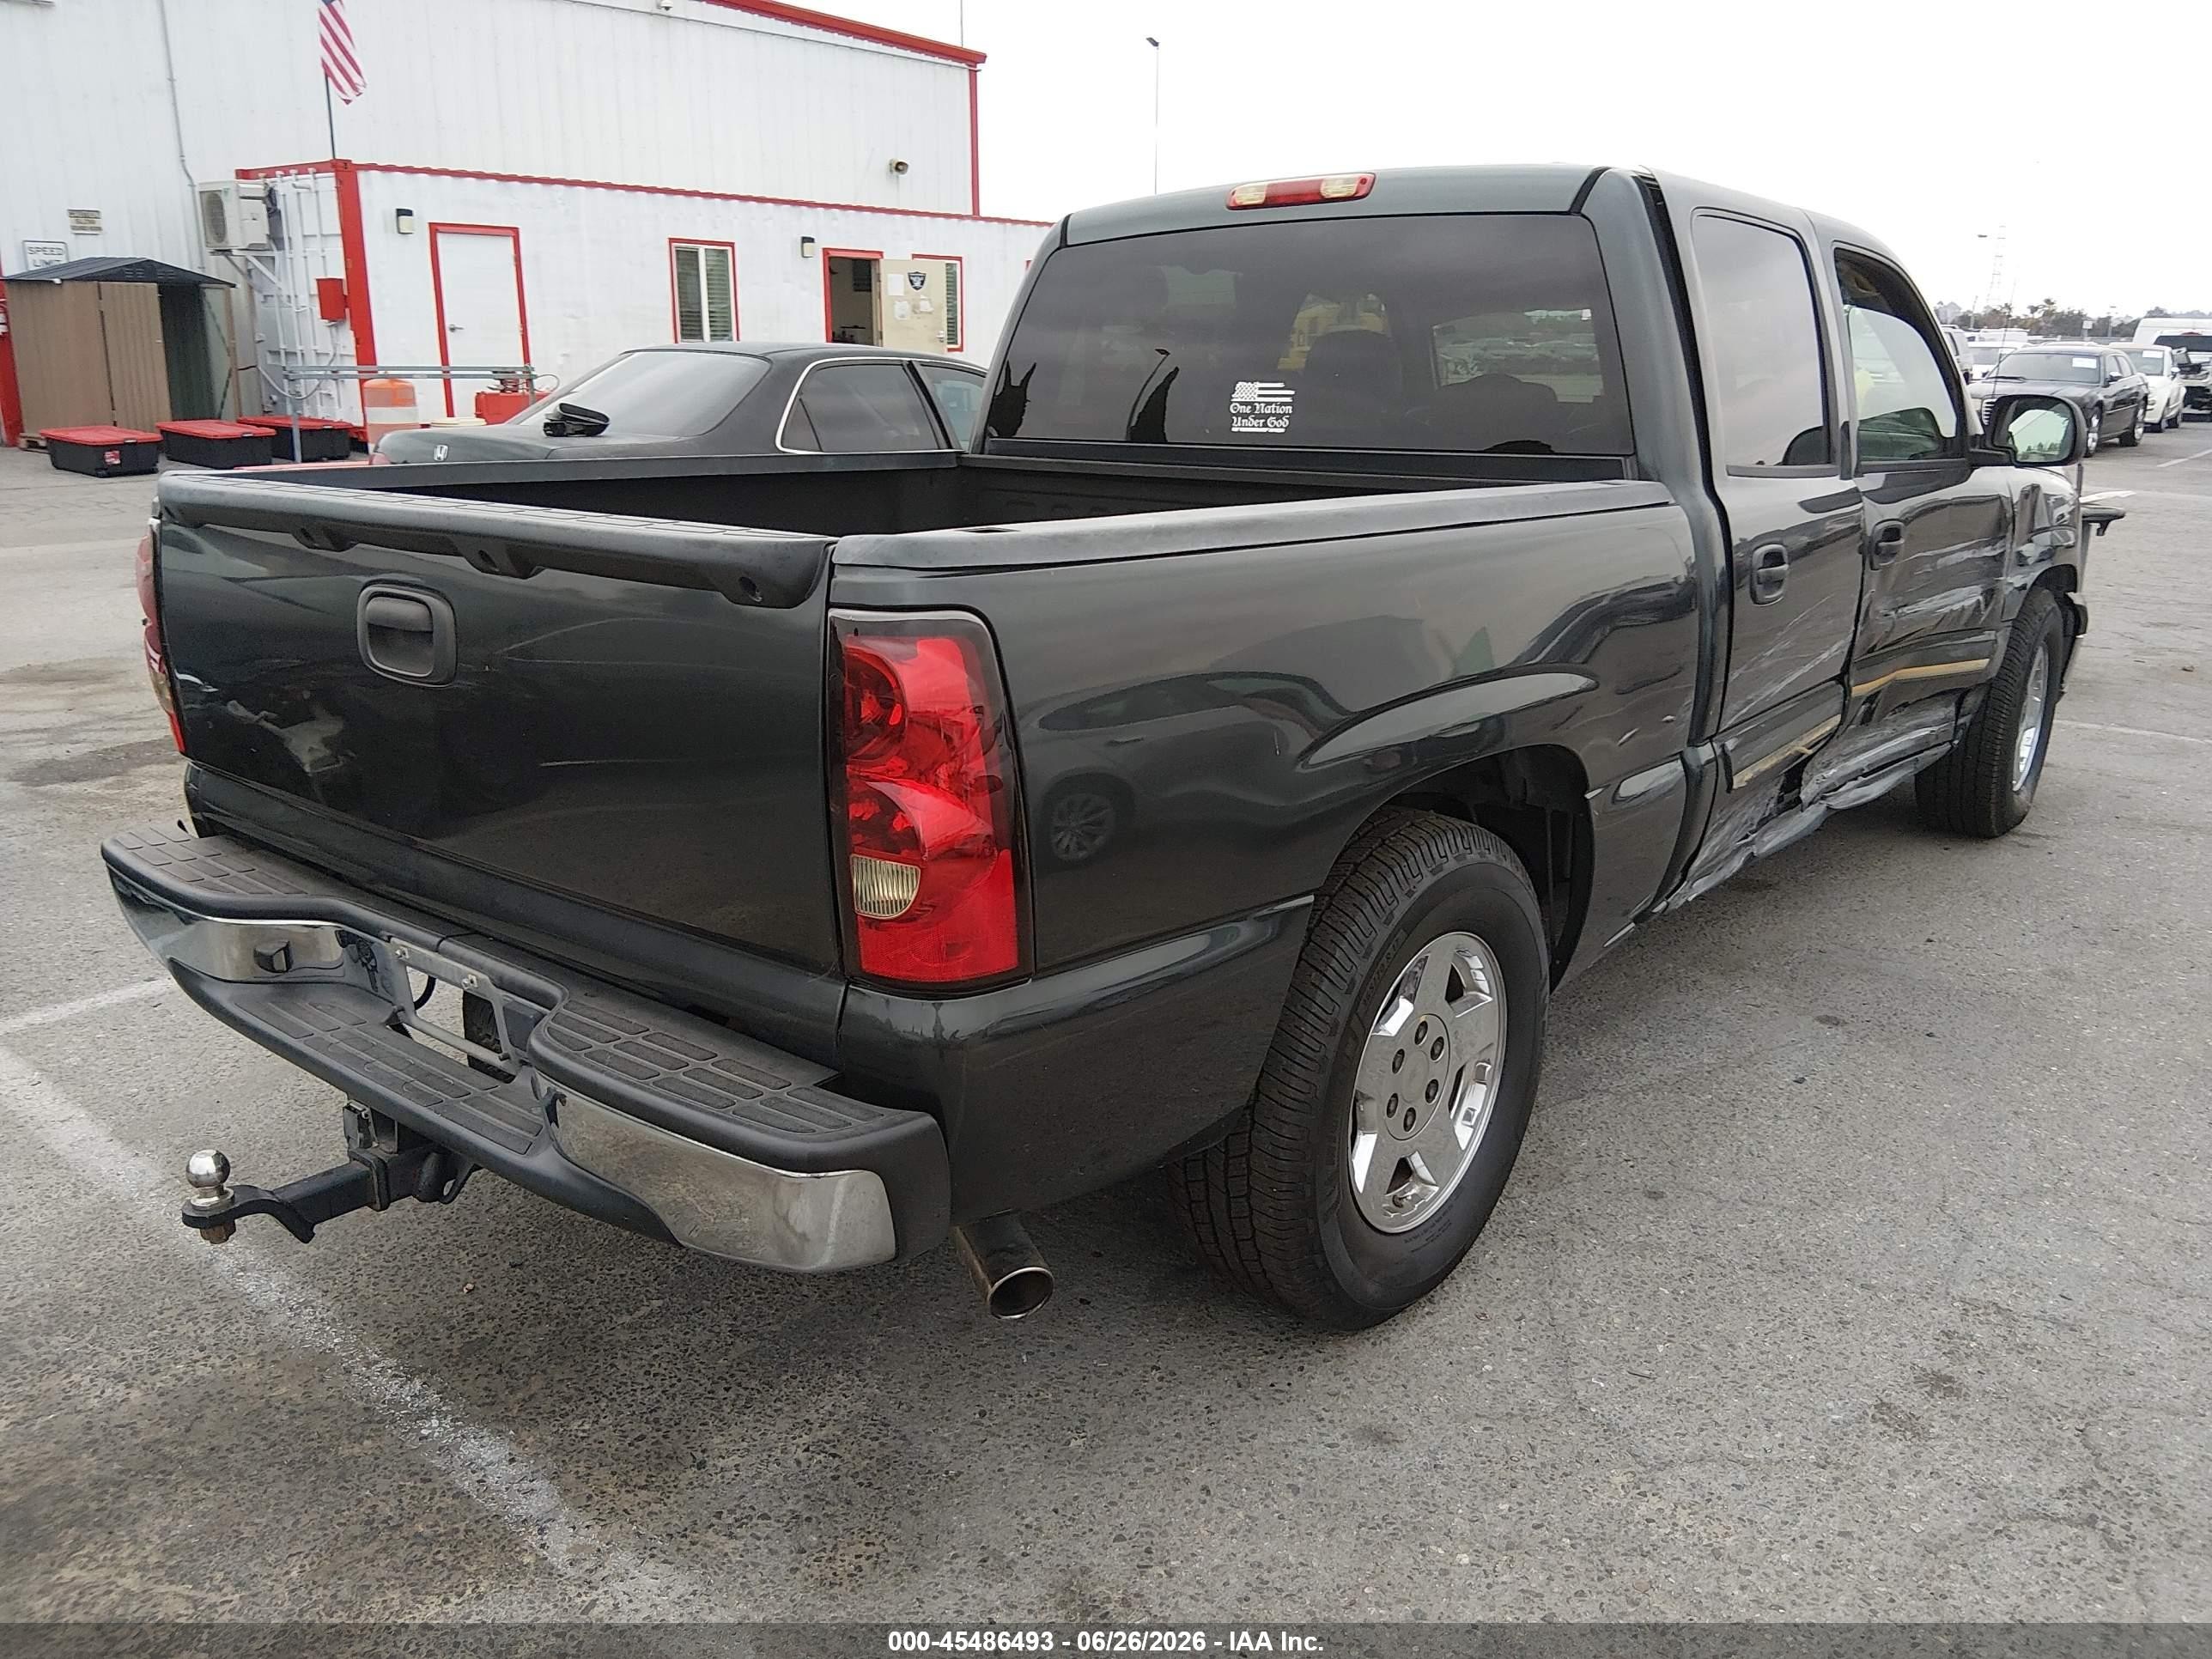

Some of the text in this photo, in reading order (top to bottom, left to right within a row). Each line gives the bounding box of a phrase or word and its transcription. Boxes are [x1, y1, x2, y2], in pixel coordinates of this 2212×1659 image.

[27, 246, 64, 256] SPEED
[1230, 402, 1293, 414] One Nation
[1231, 415, 1290, 428] Under God
